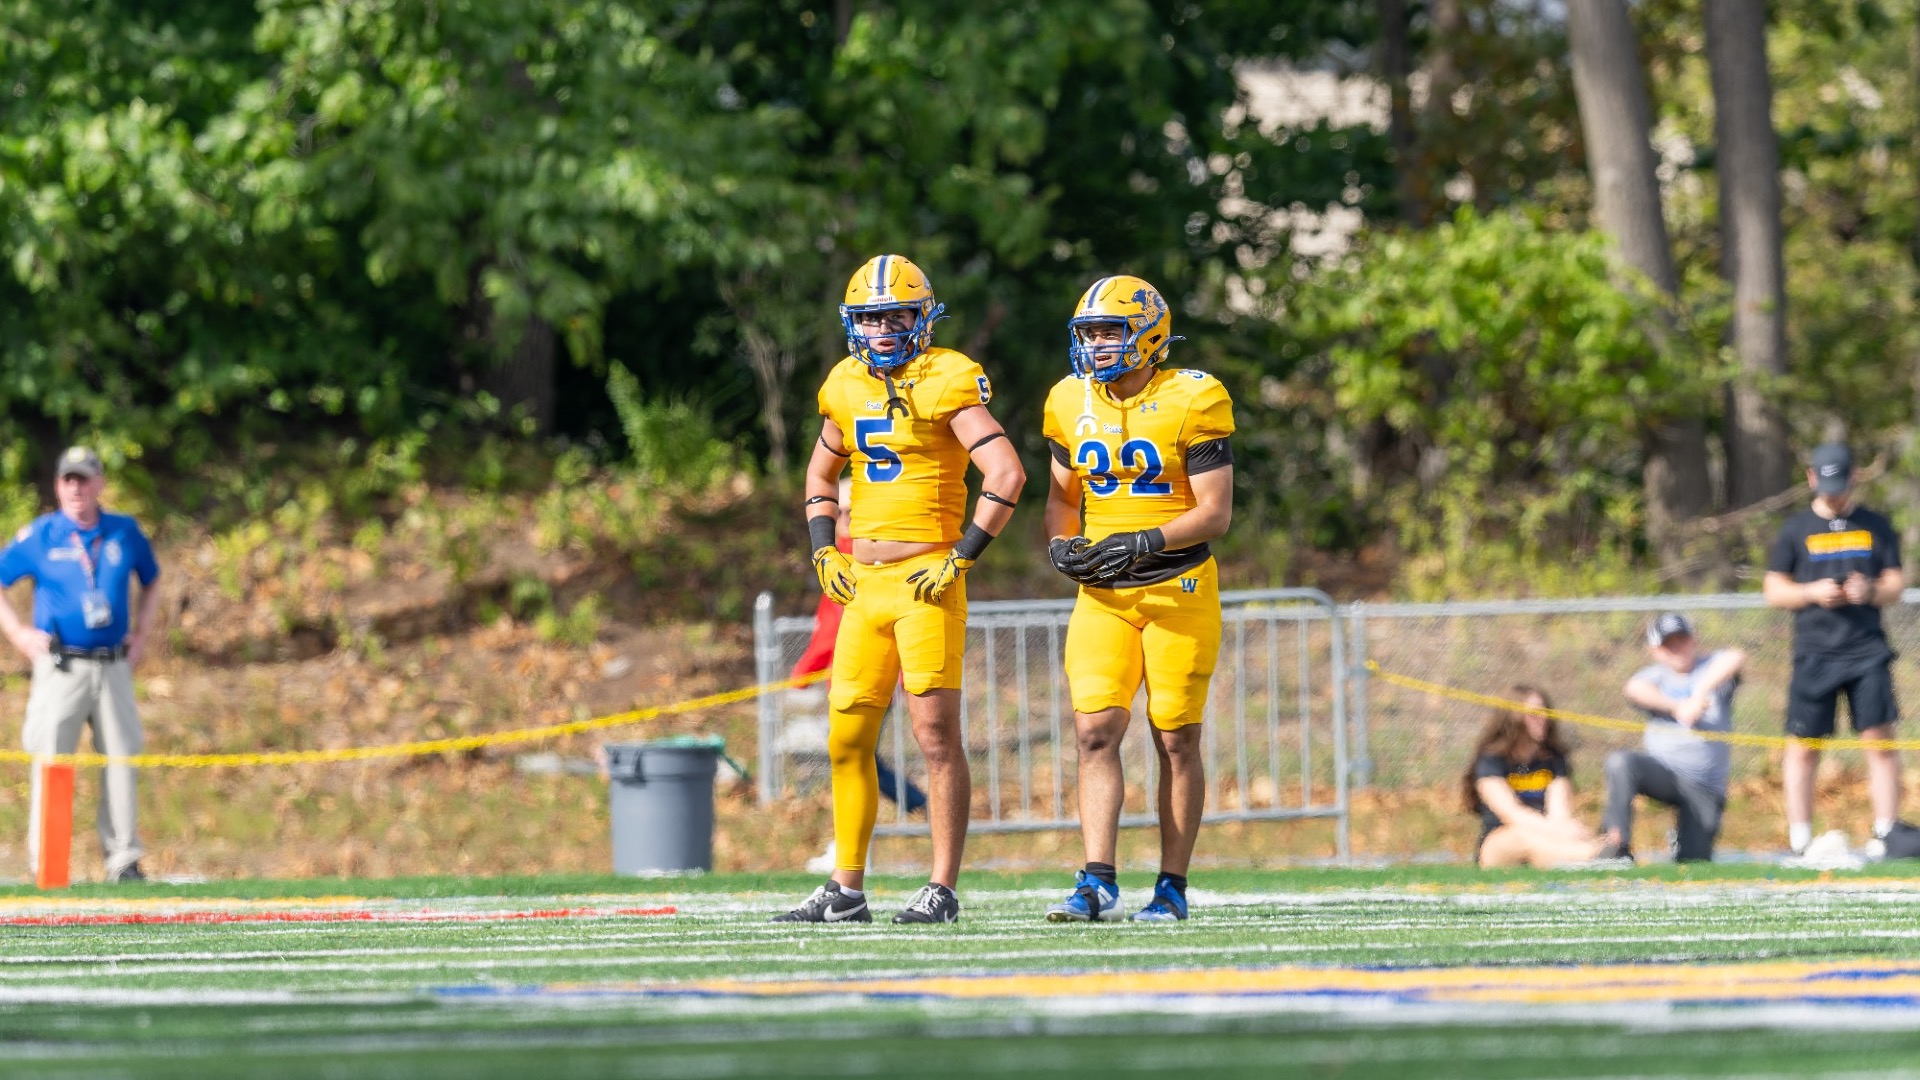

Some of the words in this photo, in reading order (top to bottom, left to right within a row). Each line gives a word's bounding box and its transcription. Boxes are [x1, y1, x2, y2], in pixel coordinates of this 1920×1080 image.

[975, 375, 990, 405] 5
[854, 416, 904, 484] 5
[1076, 438, 1173, 497] 32
[1180, 577, 1198, 594] W
